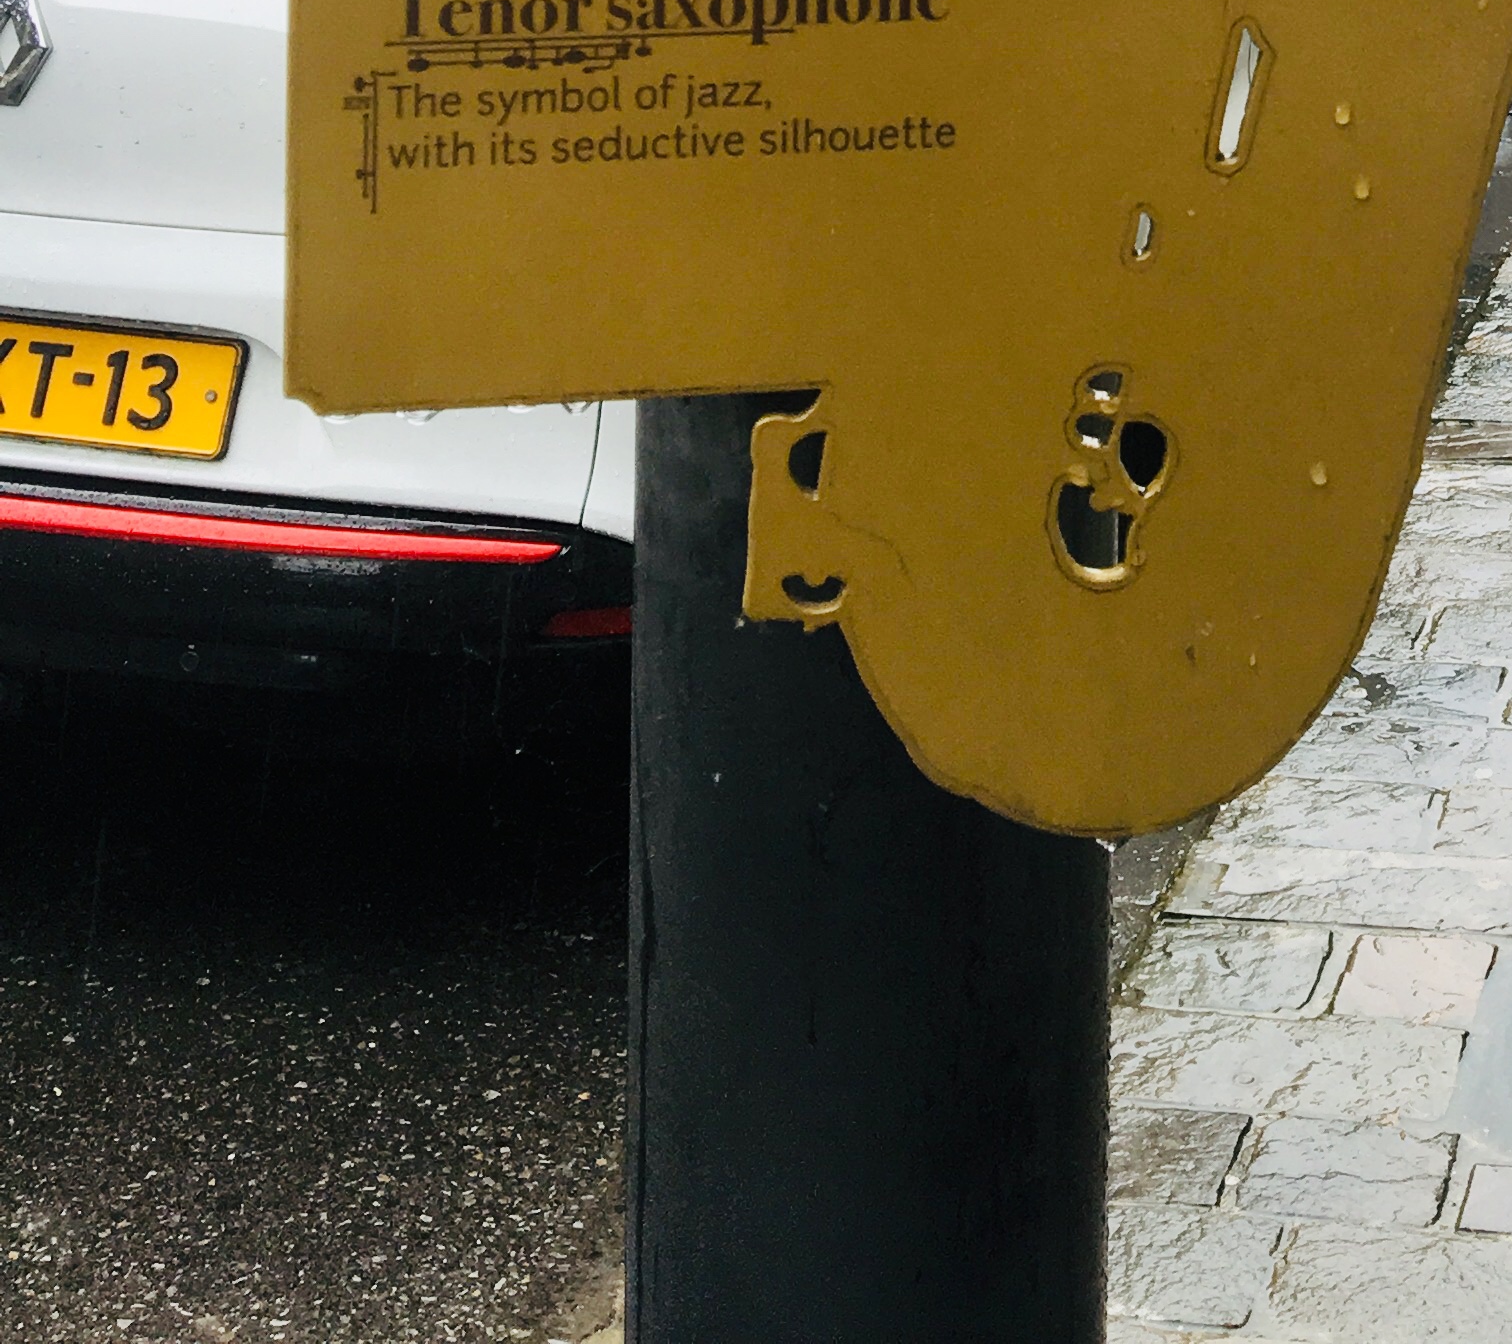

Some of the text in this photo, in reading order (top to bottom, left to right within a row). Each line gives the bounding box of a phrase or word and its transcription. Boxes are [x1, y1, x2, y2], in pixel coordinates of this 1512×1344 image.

[387, 73, 772, 126] The symbol of jazz,
[387, 116, 956, 169] with its seductive silhouette
